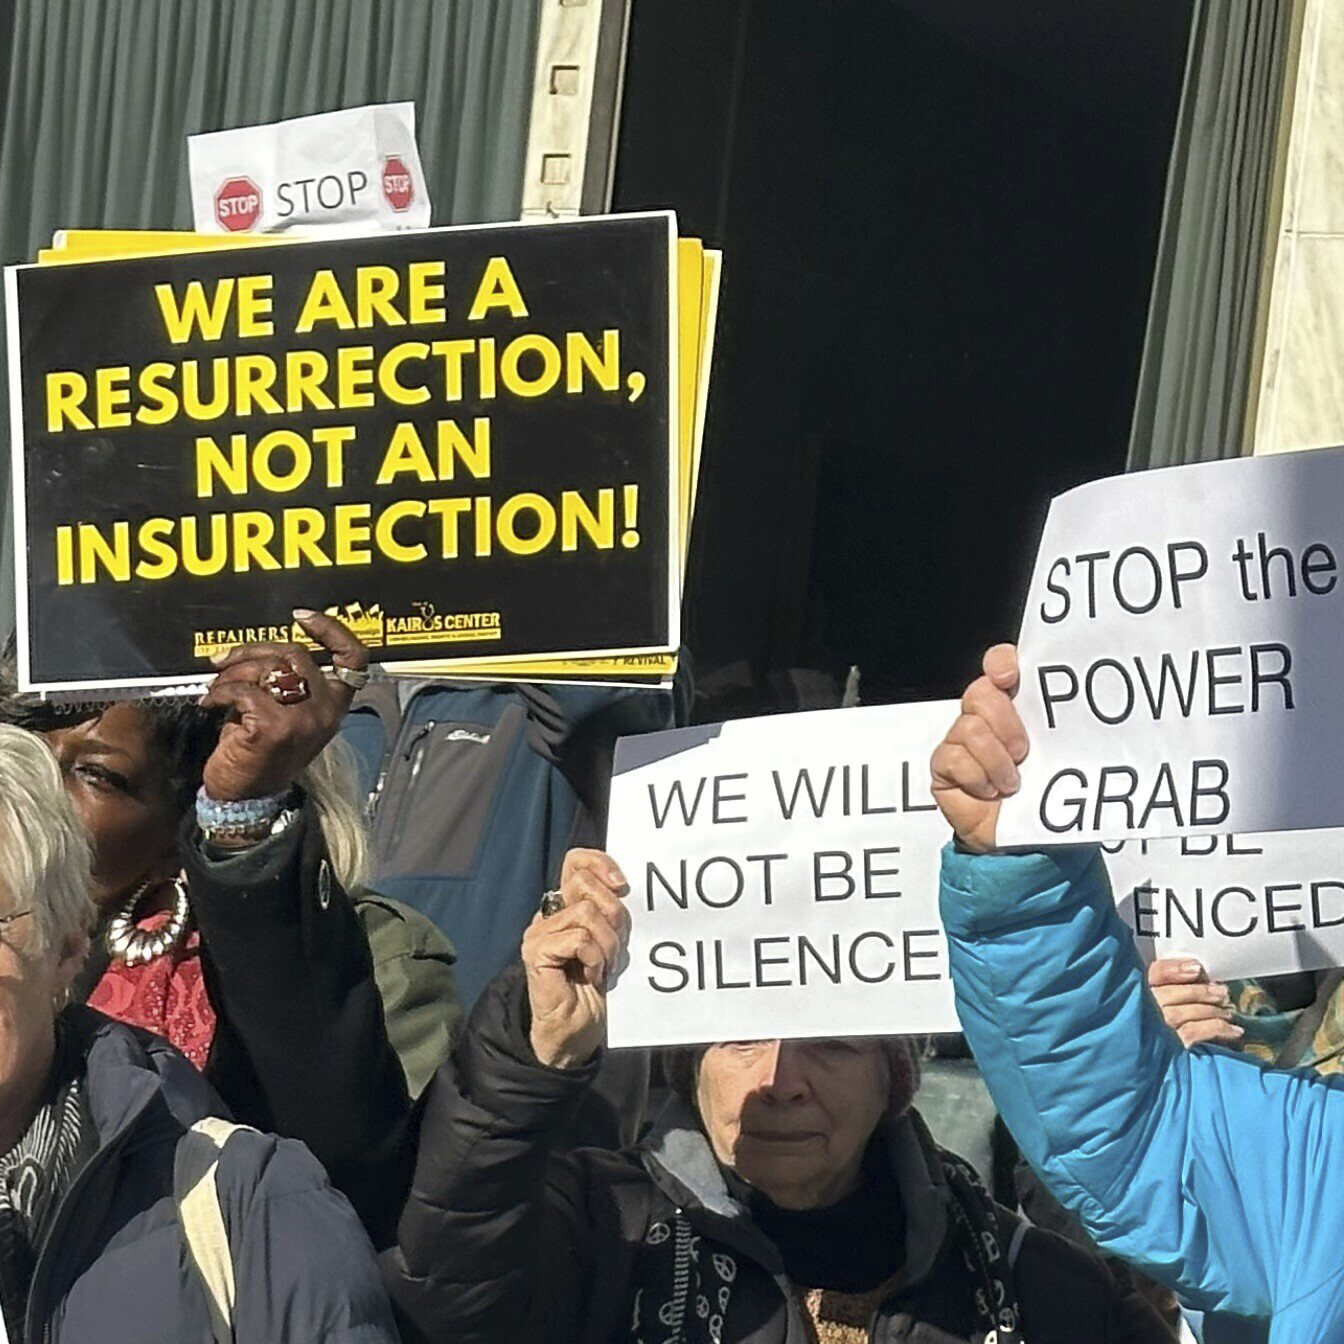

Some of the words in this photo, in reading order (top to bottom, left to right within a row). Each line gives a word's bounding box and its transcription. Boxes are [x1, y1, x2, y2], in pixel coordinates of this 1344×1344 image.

[218, 195, 258, 217] STOP
[277, 171, 368, 217] STOP
[384, 174, 411, 193] STOP
[154, 274, 275, 345] WE
[294, 263, 447, 335] ARE
[468, 257, 528, 320] A
[45, 330, 647, 434] RESURRECTION,
[196, 427, 356, 498] NOT
[376, 417, 491, 486] AN
[55, 485, 641, 586] INSURRECTION!
[1041, 541, 1209, 624] STOP
[1232, 532, 1338, 601] the
[444, 612, 500, 629] CENTER
[1038, 643, 1295, 728] POWER
[648, 773, 749, 829] WE
[772, 761, 937, 820] WILL
[1039, 759, 1231, 833] GRAB
[646, 853, 788, 911] NOT
[814, 847, 902, 902] BE
[1134, 881, 1344, 939] ENCED
[648, 929, 953, 993] SILENCE
